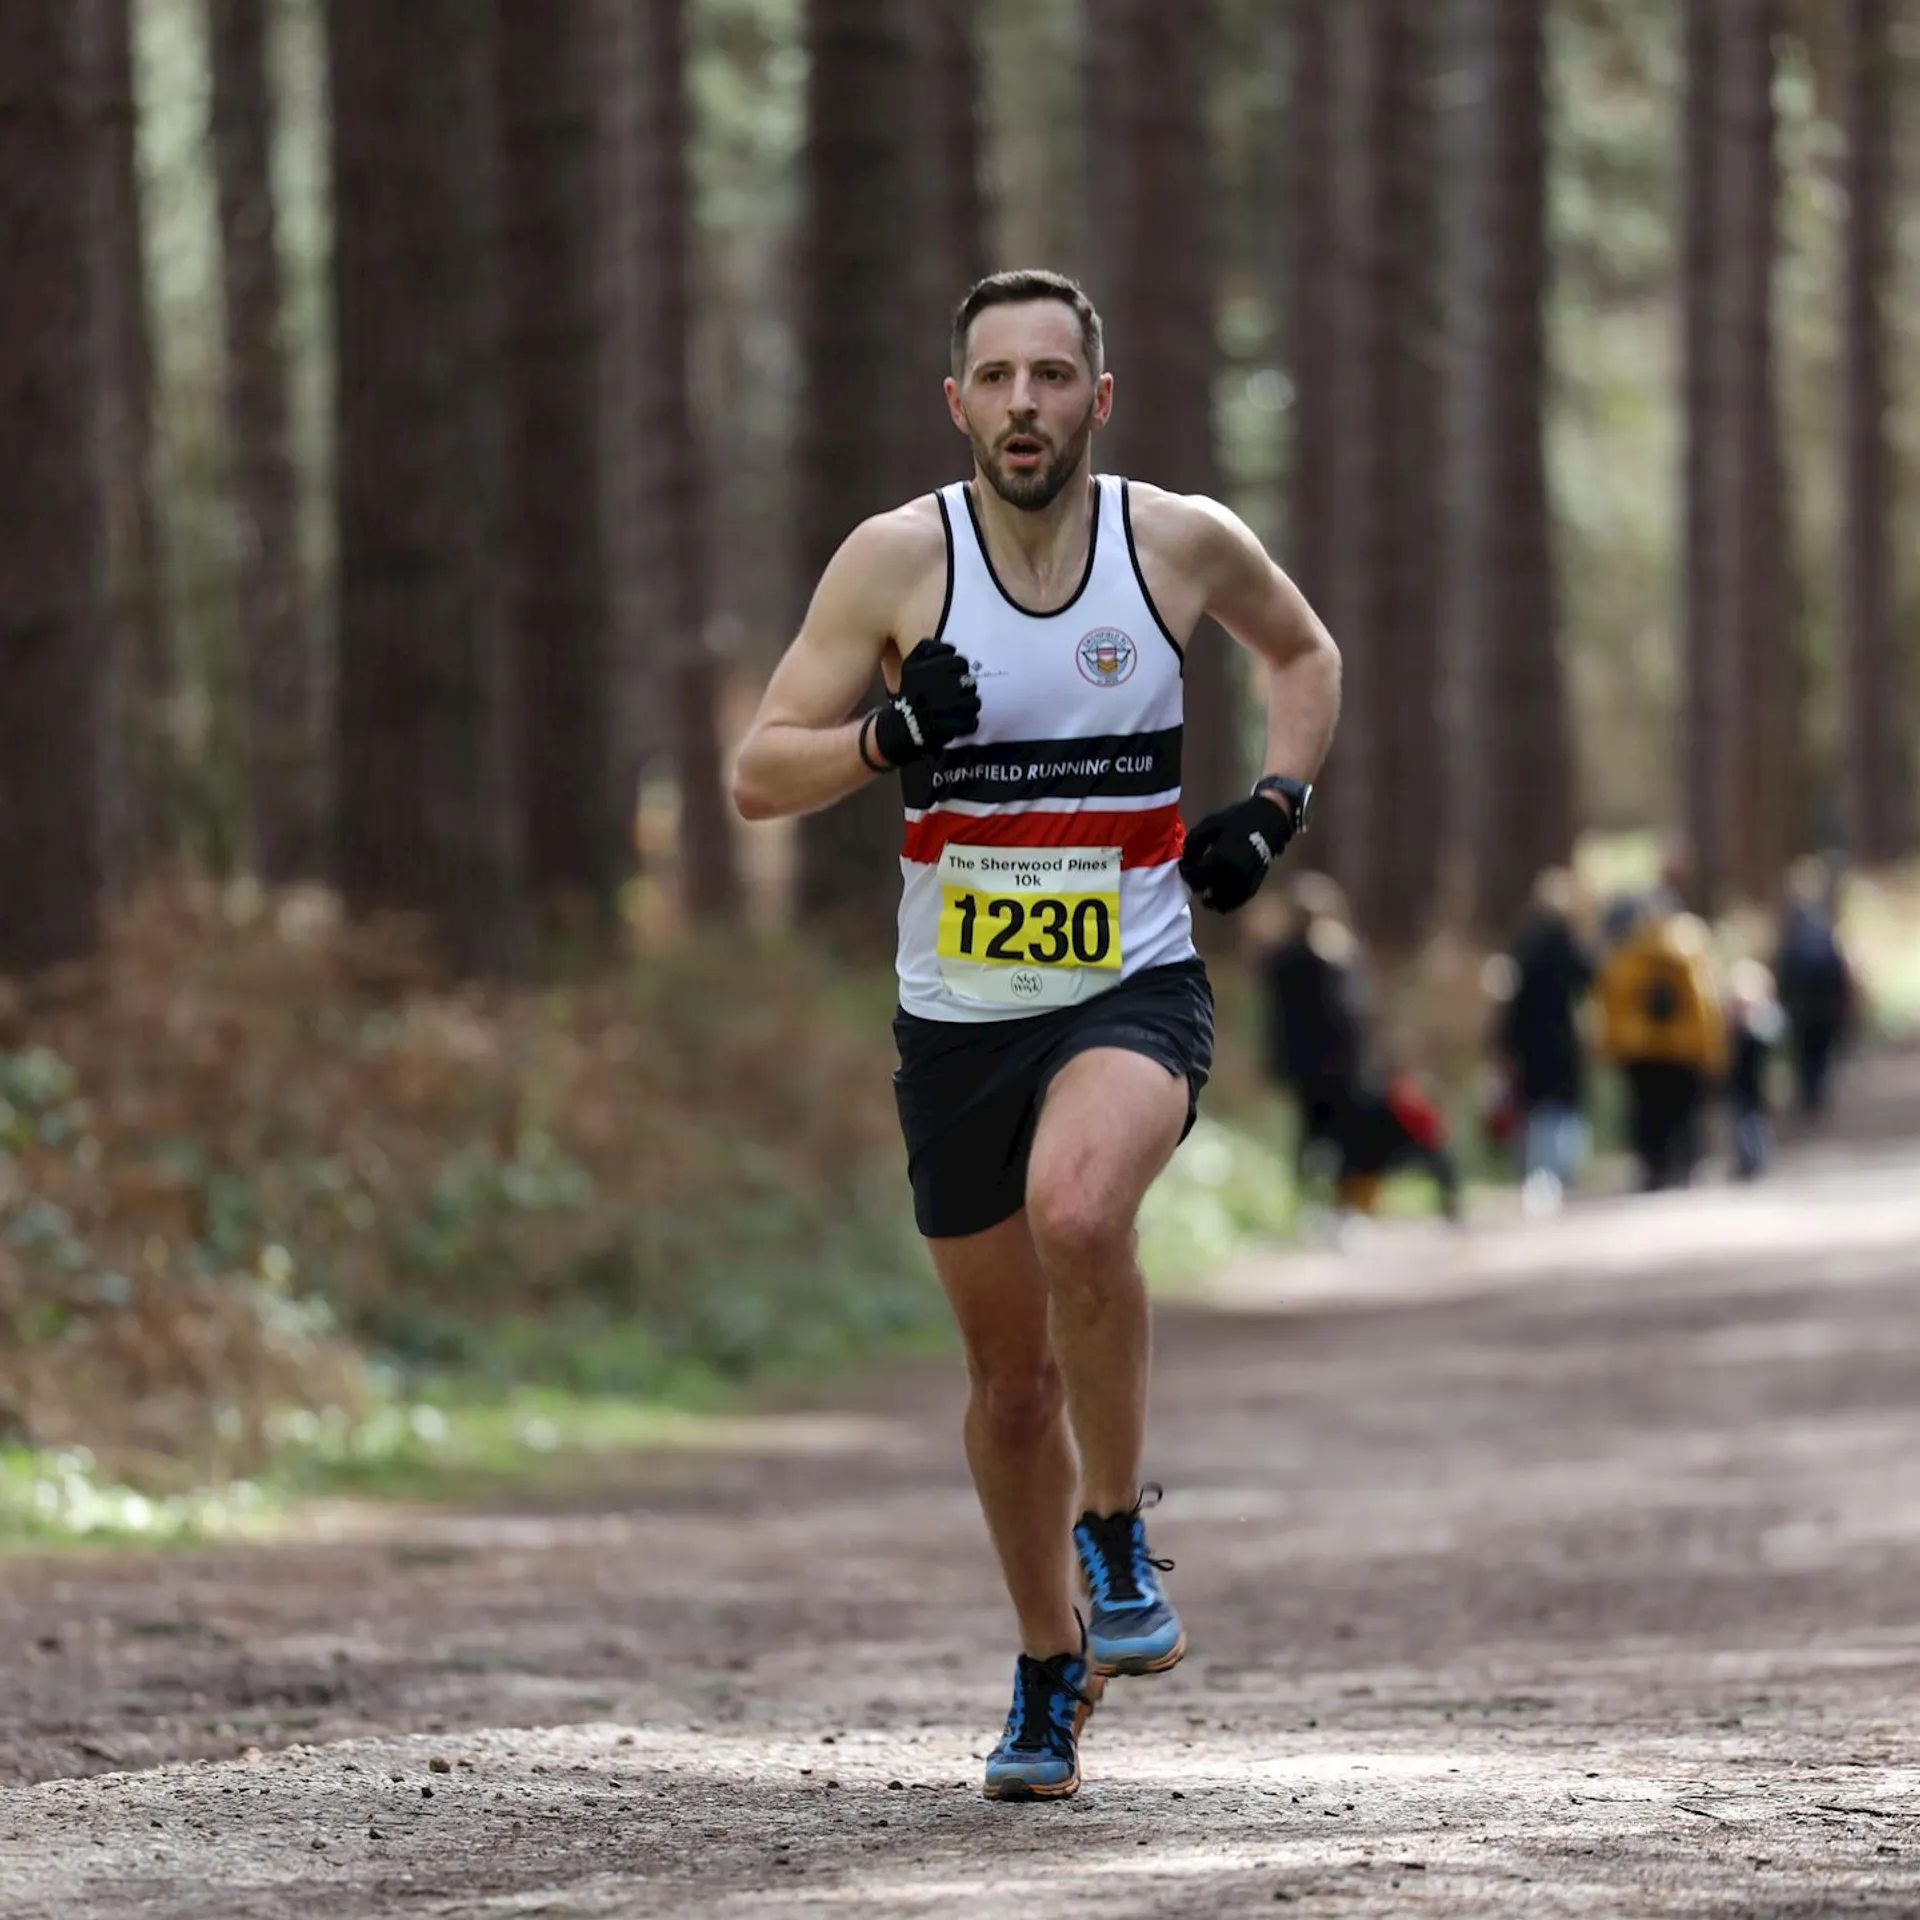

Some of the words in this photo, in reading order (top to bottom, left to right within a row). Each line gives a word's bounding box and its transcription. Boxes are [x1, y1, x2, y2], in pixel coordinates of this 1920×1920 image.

[1026, 759, 1111, 780] RUNNING
[1115, 755, 1153, 773] CLUB
[949, 855, 975, 871] The
[981, 858, 1063, 872] Sherwood
[1068, 858, 1108, 872] Pines
[1015, 874, 1042, 887] 10k
[954, 893, 1111, 963] 1230
